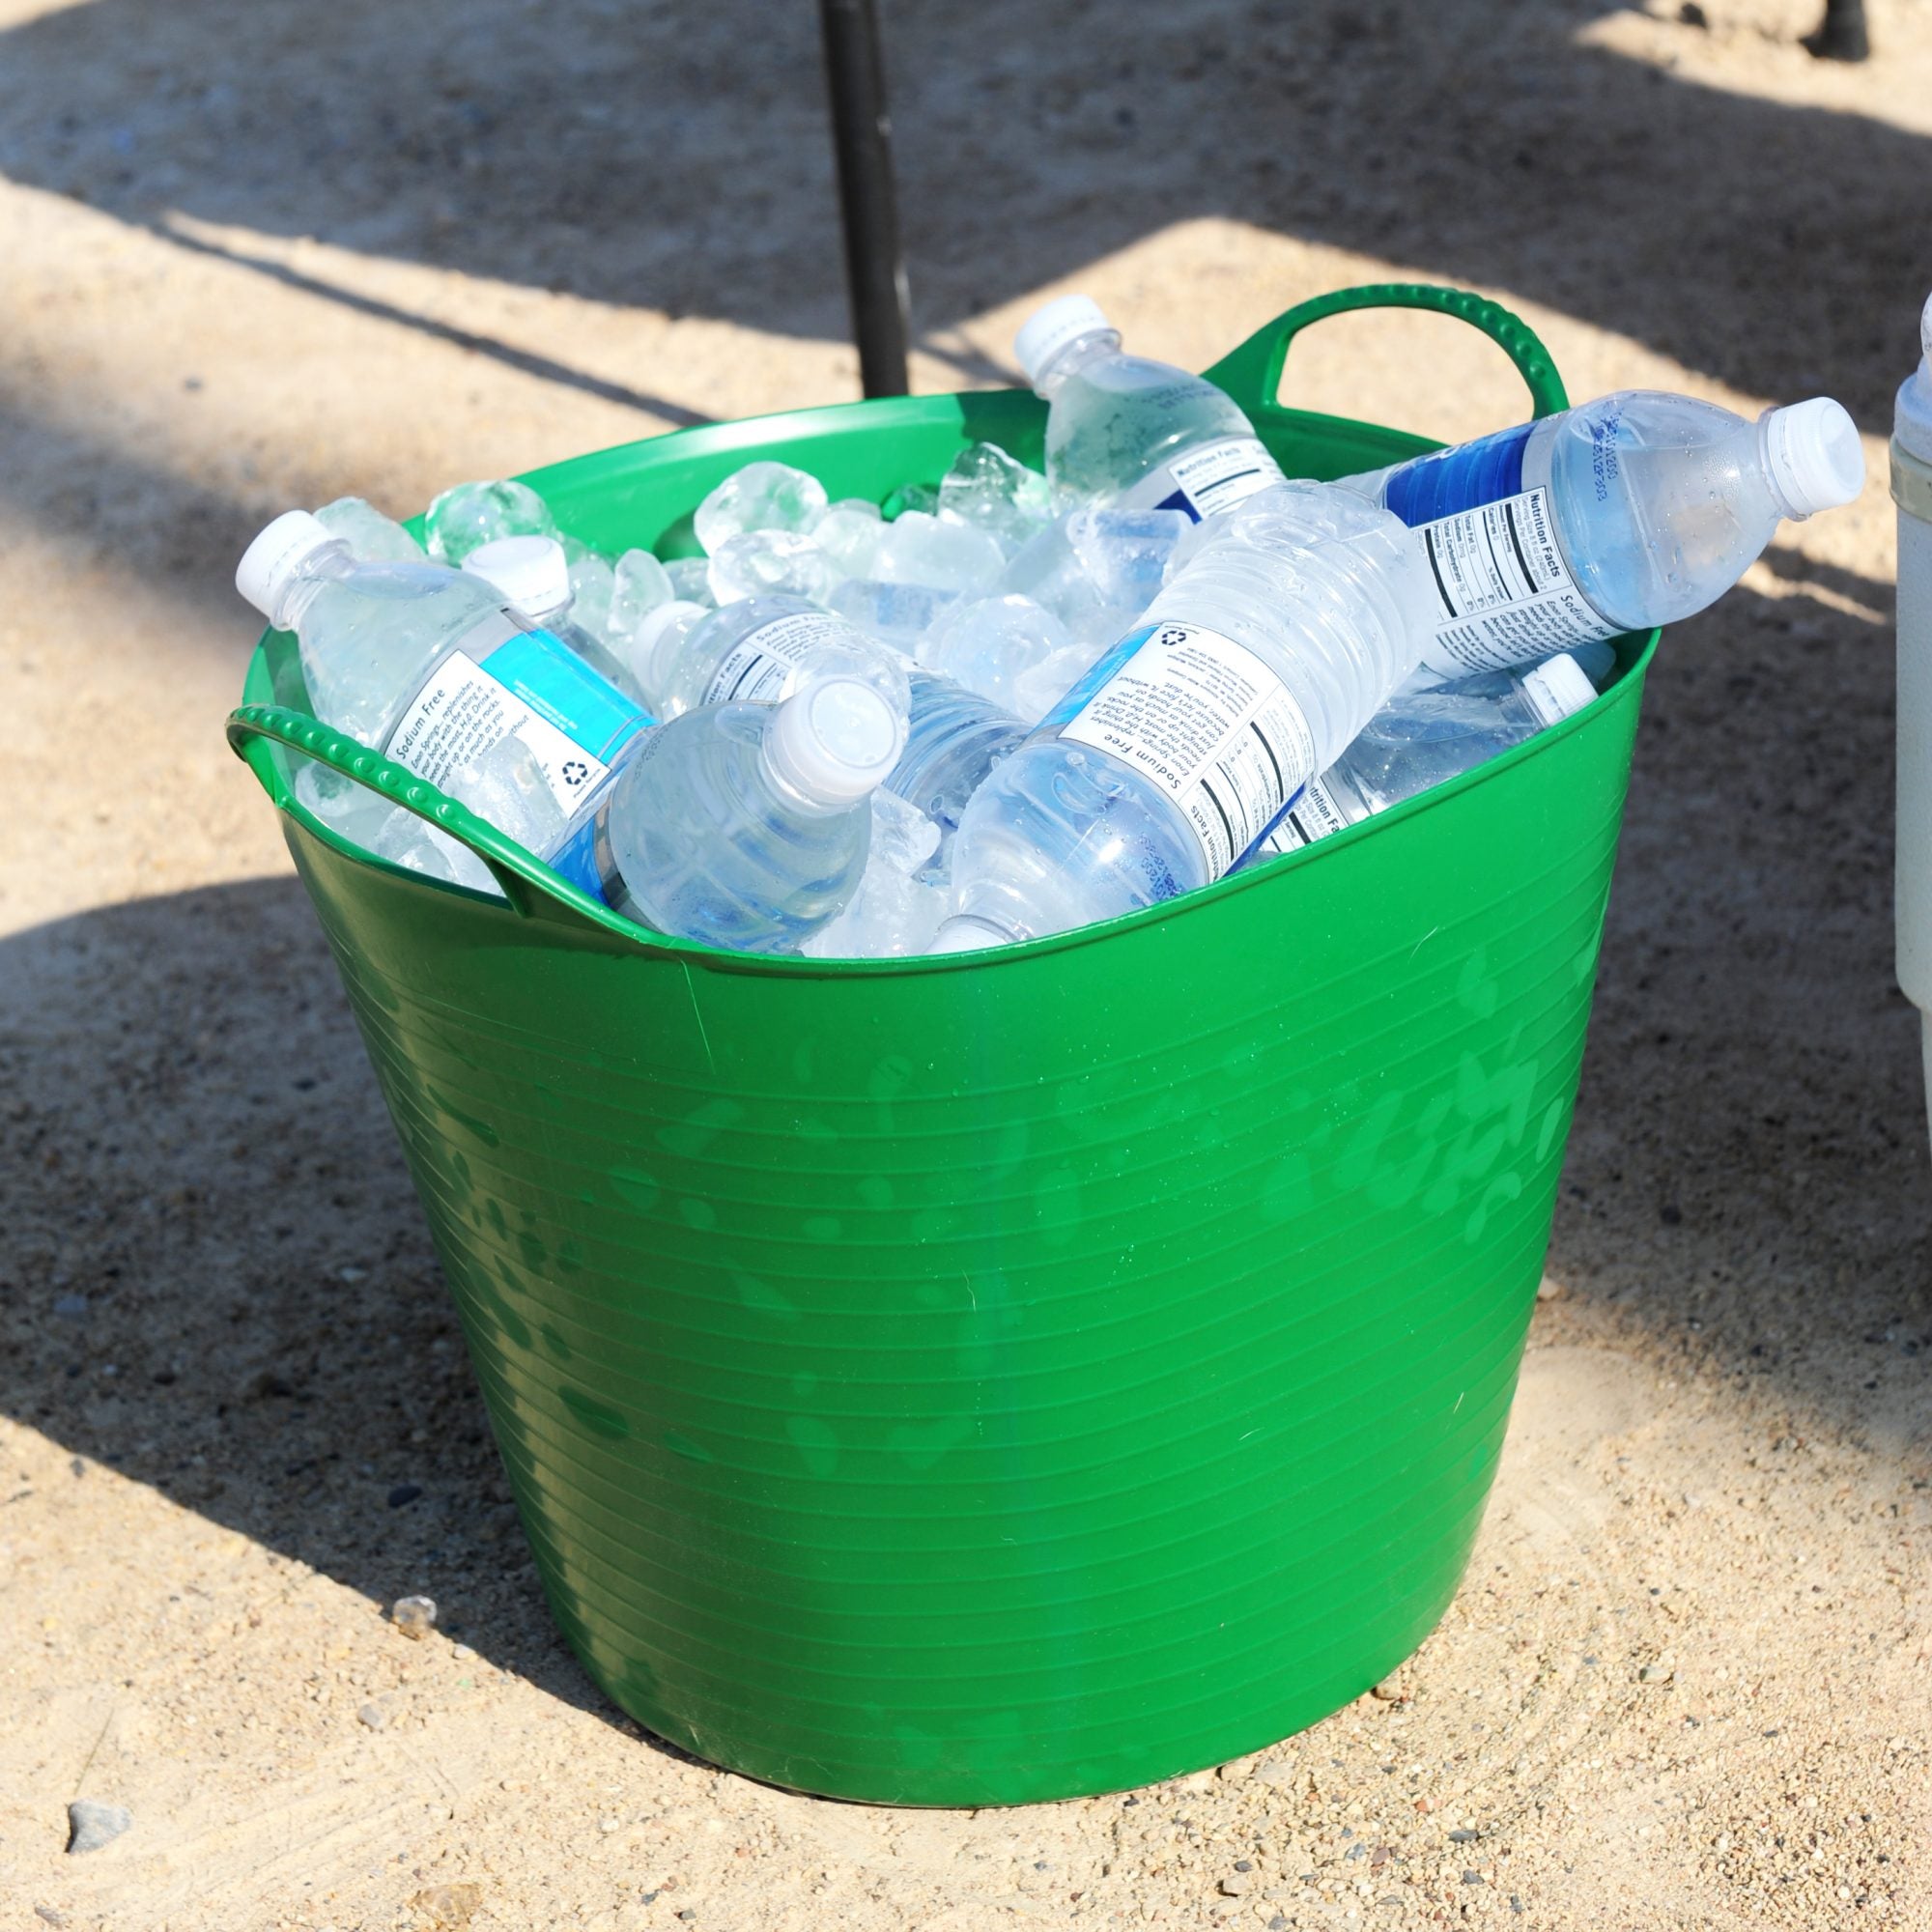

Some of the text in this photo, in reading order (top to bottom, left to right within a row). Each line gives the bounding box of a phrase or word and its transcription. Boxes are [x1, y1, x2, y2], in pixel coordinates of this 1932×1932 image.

[1442, 521, 1451, 538] Total
[1453, 517, 1463, 542] Sodium
[1463, 515, 1472, 531] Total
[1487, 507, 1498, 535] Calories
[1432, 525, 1442, 549] Protein
[1466, 531, 1475, 544] Fat
[1518, 526, 1526, 538] Per
[1530, 493, 1562, 578] Nutrition Facts
[1445, 538, 1463, 582] Carbohydrate
[1520, 538, 1537, 568] Container
[1559, 592, 1592, 627] Sodium
[1118, 690, 1134, 698] you
[1158, 688, 1179, 701] face
[1102, 701, 1125, 715] Drink
[1102, 708, 1123, 724] thing
[1129, 703, 1144, 714] the
[1134, 687, 1219, 742] can get your hands on
[1145, 698, 1169, 715] much
[1145, 709, 1157, 719] on
[1168, 712, 1179, 721] as
[394, 687, 445, 759] Sodium Free
[410, 749, 424, 769] Enon
[440, 678, 474, 722] replenishes
[1090, 715, 1135, 738] replenishes
[1123, 720, 1138, 730] the
[1156, 716, 1167, 724] or
[1166, 721, 1179, 733] up
[1194, 708, 1225, 736] because
[1207, 707, 1231, 729] water,
[418, 758, 431, 777] your
[426, 739, 444, 760] body
[438, 723, 453, 741] with
[449, 710, 462, 724] the
[459, 691, 479, 711] thing
[426, 761, 441, 781] needs
[438, 749, 448, 762] the
[470, 692, 490, 714] Drink
[462, 709, 504, 763] as much as you
[493, 725, 504, 737] on
[1139, 725, 1158, 740] with
[1165, 731, 1179, 745] the
[1177, 719, 1199, 738] drink
[449, 751, 461, 764] up
[457, 741, 467, 752] or
[463, 731, 473, 743] on
[469, 717, 484, 732] the
[1156, 736, 1179, 755] body
[1177, 729, 1208, 756] straight
[1197, 735, 1214, 751] Just
[1103, 732, 1181, 789] Sodium Free
[1178, 753, 1197, 769] your
[1179, 742, 1202, 762] needs
[1169, 757, 1190, 777] Enon
[1309, 787, 1332, 819] trition
[1188, 804, 1210, 837] Facts
